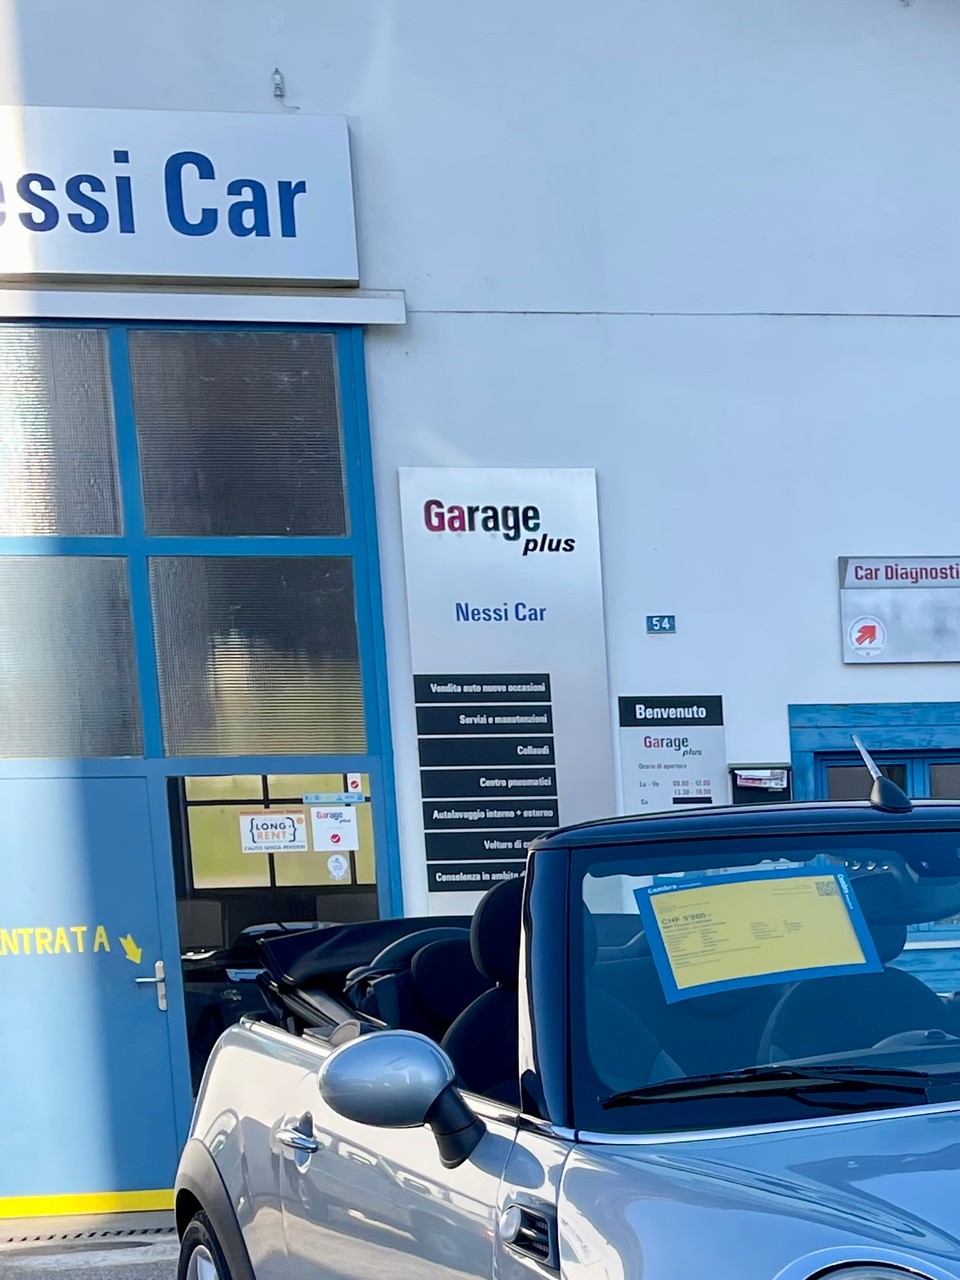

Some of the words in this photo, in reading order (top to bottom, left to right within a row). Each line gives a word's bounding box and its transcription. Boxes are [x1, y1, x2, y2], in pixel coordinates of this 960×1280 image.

[0, 150, 136, 234] ssi
[164, 151, 307, 238] Car
[423, 498, 541, 541] Garage
[522, 533, 576, 556] plus
[854, 565, 880, 580] Car
[455, 602, 509, 622] Nessi
[515, 602, 547, 621] Car
[652, 617, 671, 630] 54
[430, 683, 462, 693] Vendita
[463, 684, 481, 693] auto
[508, 682, 546, 692] occasioni
[635, 704, 707, 719] Benvenuto
[459, 715, 487, 724] Servizi
[495, 714, 547, 723] manutenzioni
[644, 736, 689, 751] Garage
[517, 745, 550, 755] Collaudi
[682, 748, 702, 757] plus
[480, 778, 506, 787] Centro
[508, 777, 551, 788] pneumatici
[316, 811, 343, 821] Garage
[432, 809, 485, 820] Autolavaggio
[486, 809, 514, 818] interno
[523, 809, 554, 818] esterno
[255, 822, 287, 831] LONG
[256, 831, 287, 840] RENT
[0, 925, 111, 956] NTRATA
